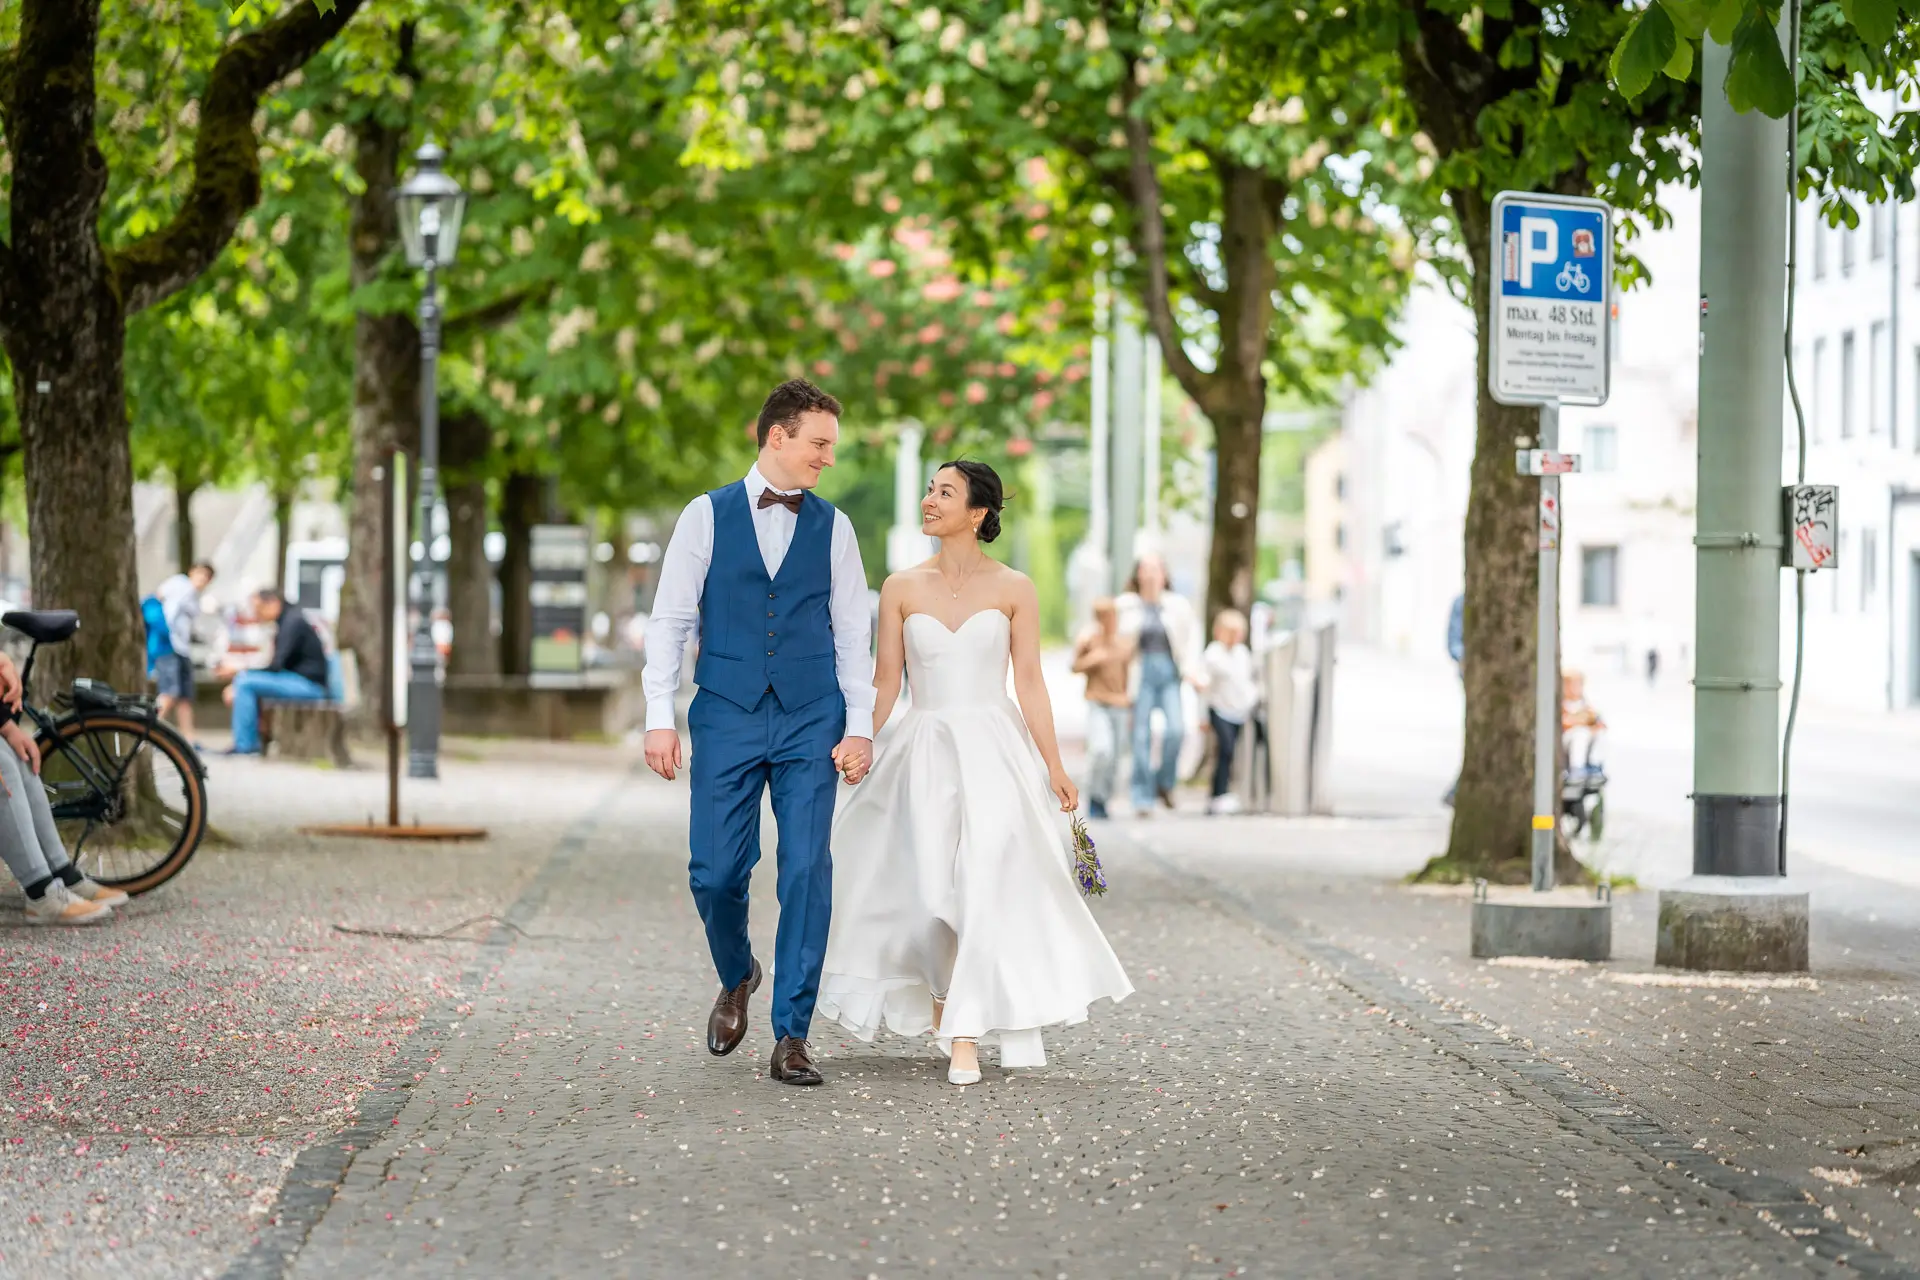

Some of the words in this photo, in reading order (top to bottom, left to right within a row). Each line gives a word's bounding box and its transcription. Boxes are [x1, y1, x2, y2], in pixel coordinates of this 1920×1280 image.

[1519, 215, 1558, 289] P
[1507, 306, 1543, 322] max.
[1548, 305, 1566, 324] 48
[1571, 306, 1597, 326] Std.
[1507, 327, 1544, 344] Montag
[1547, 328, 1561, 341] bis
[1564, 329, 1597, 347] Freitag
